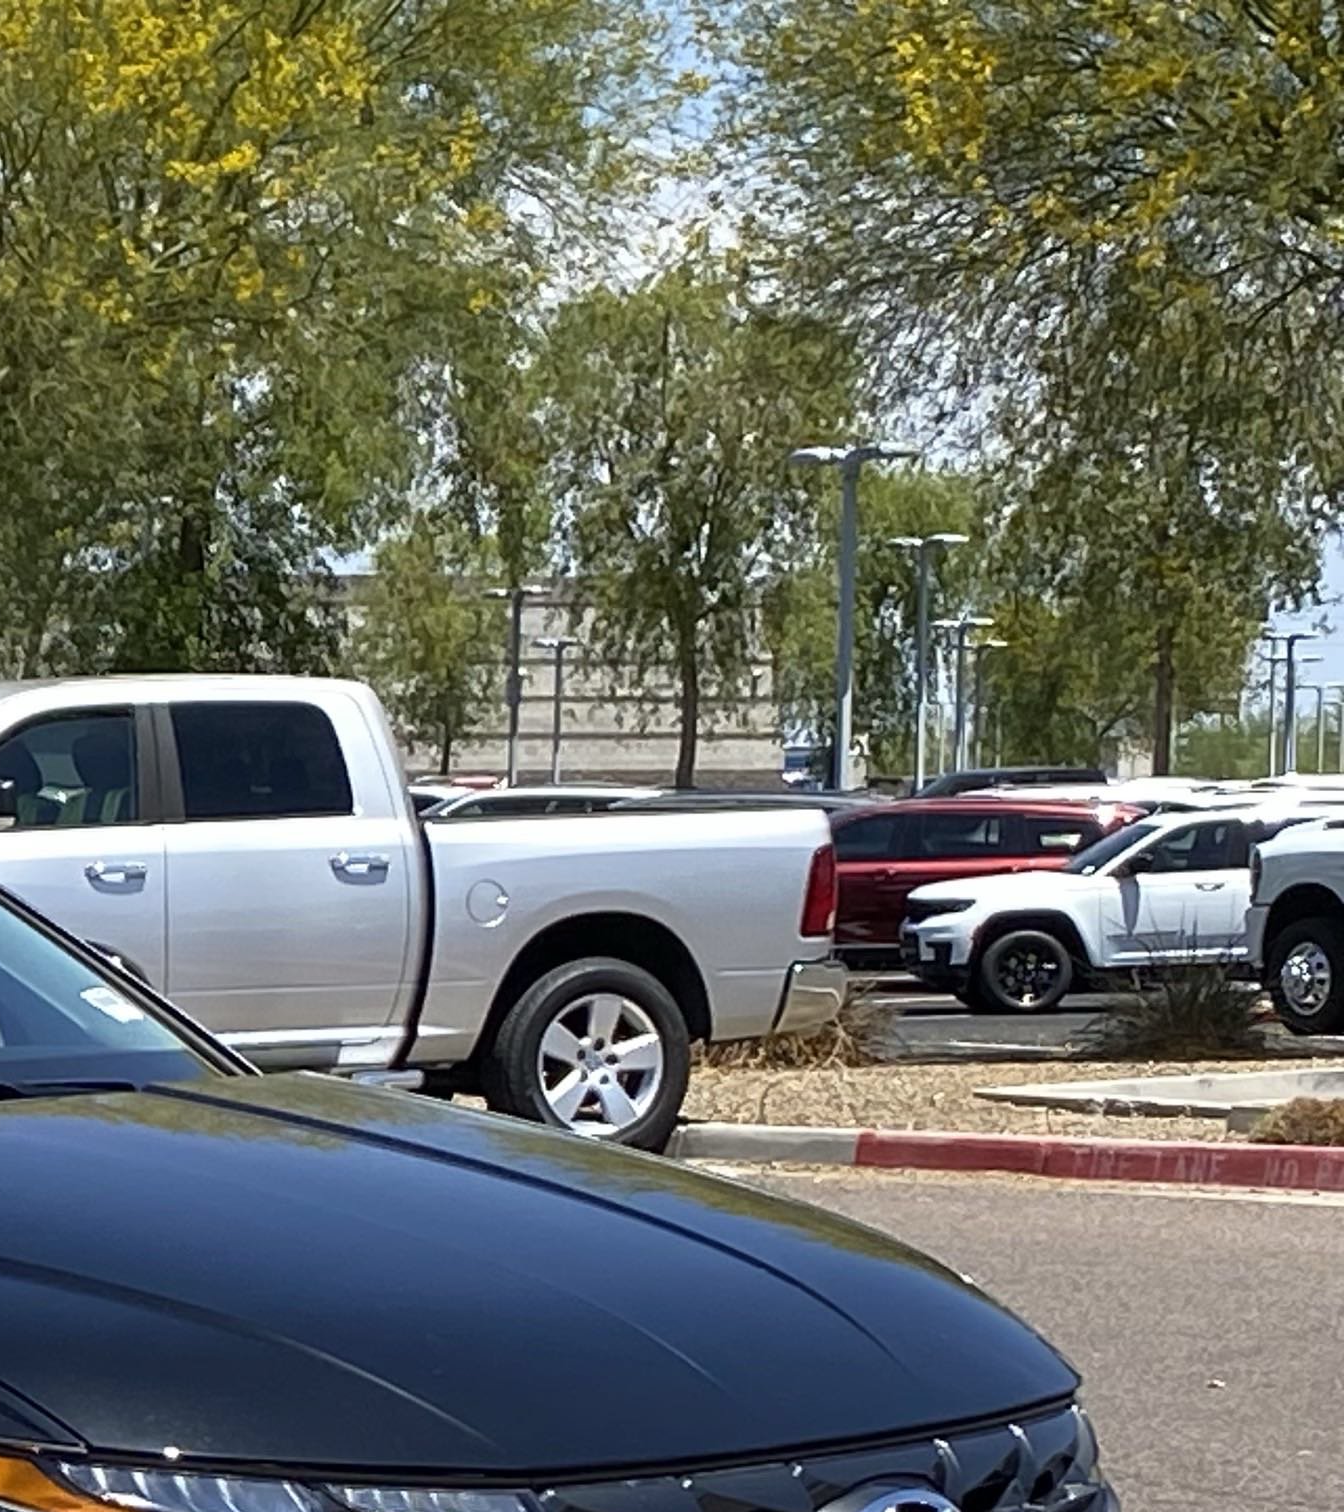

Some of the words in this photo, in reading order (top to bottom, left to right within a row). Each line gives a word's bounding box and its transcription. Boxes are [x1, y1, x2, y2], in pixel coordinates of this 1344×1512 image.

[1072, 1147, 1134, 1178] FIRE
[1151, 1151, 1227, 1183] LANE
[1263, 1156, 1299, 1188] NO
